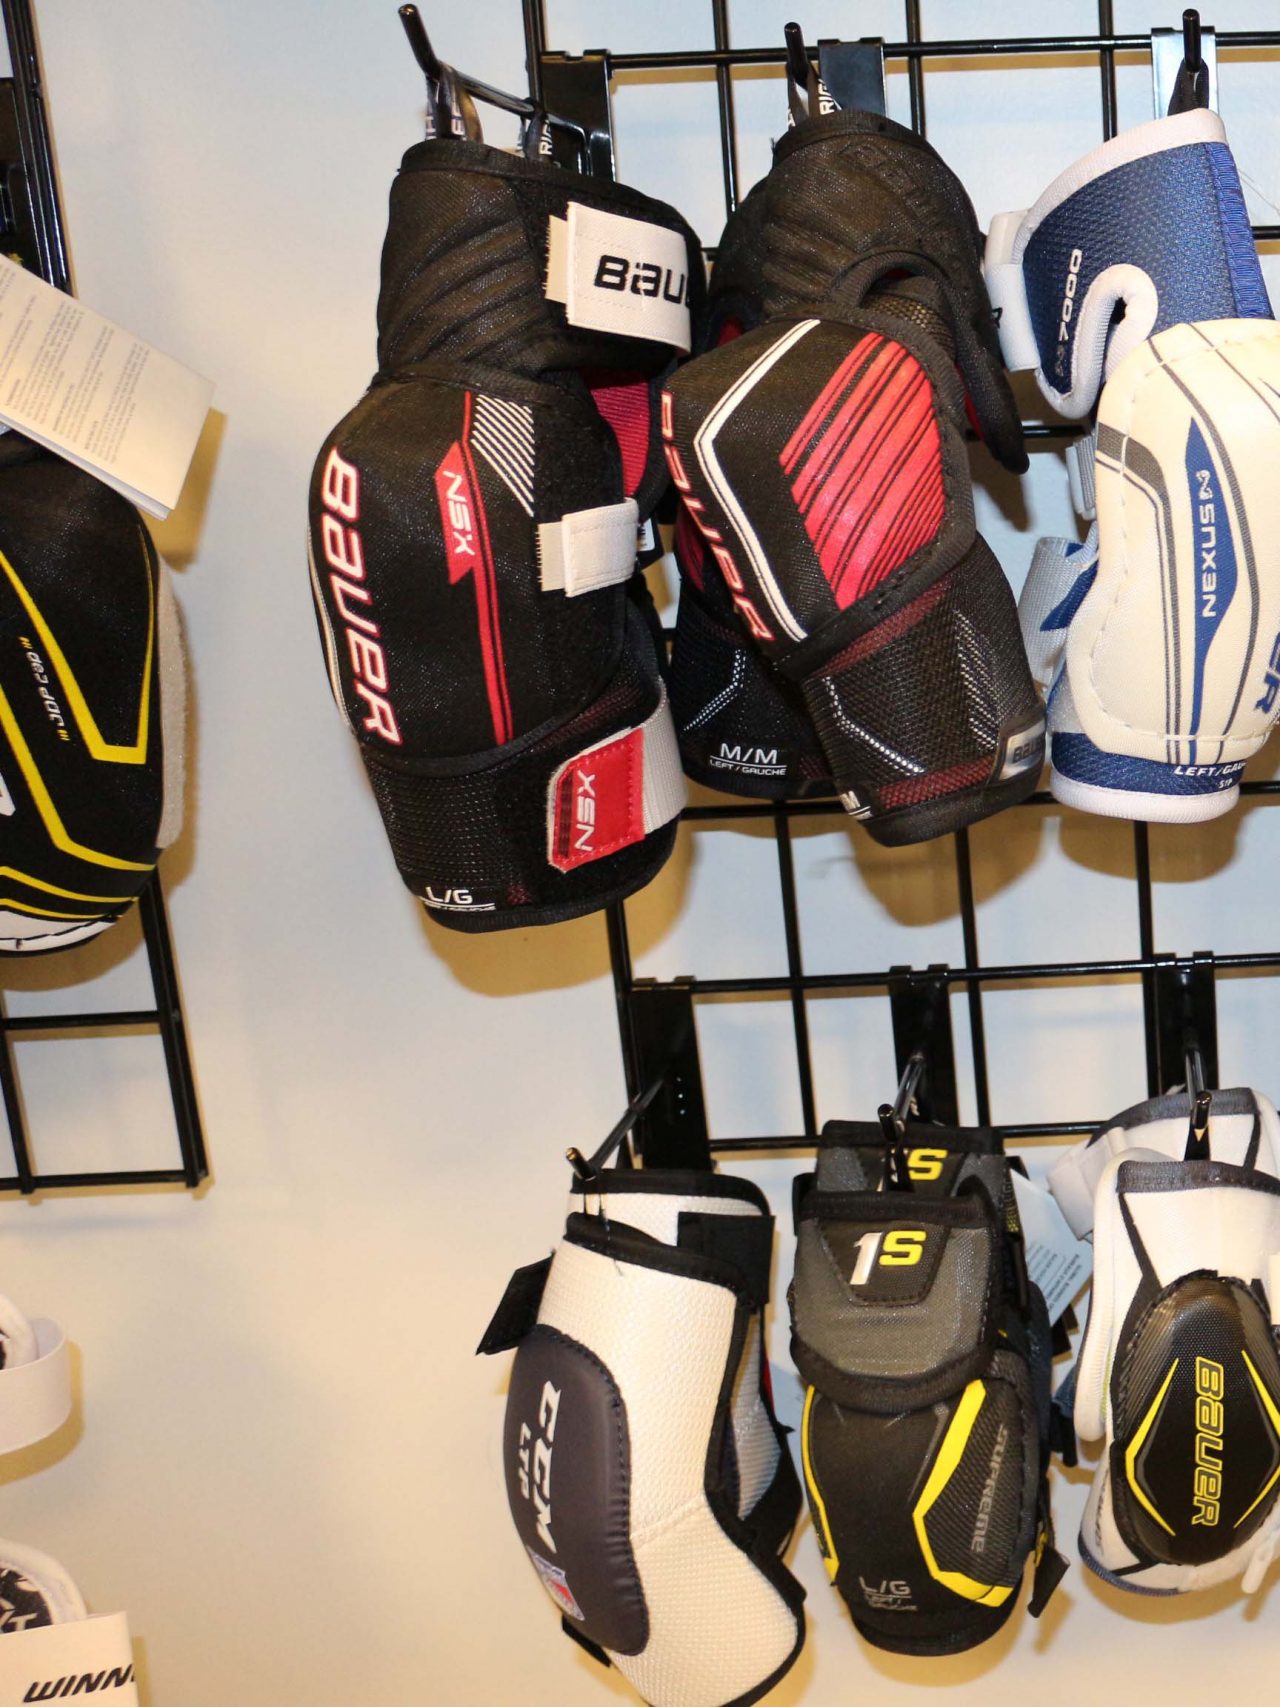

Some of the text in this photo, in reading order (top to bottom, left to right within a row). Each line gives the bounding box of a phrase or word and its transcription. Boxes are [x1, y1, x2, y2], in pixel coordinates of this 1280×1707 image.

[594, 254, 689, 306] BAU
[1061, 248, 1082, 341] 7000
[437, 471, 475, 556] NSX
[324, 448, 401, 745] BAUER
[1200, 503, 1217, 617] NEXUS
[709, 759, 733, 771] LEFT
[741, 766, 788, 776] GAUCHE
[720, 743, 778, 765] M/M
[573, 768, 596, 852] NSX
[425, 886, 474, 905] L/G
[850, 1230, 927, 1286] 1S
[532, 1380, 562, 1554] CCM
[1192, 1356, 1225, 1527] BAUER
